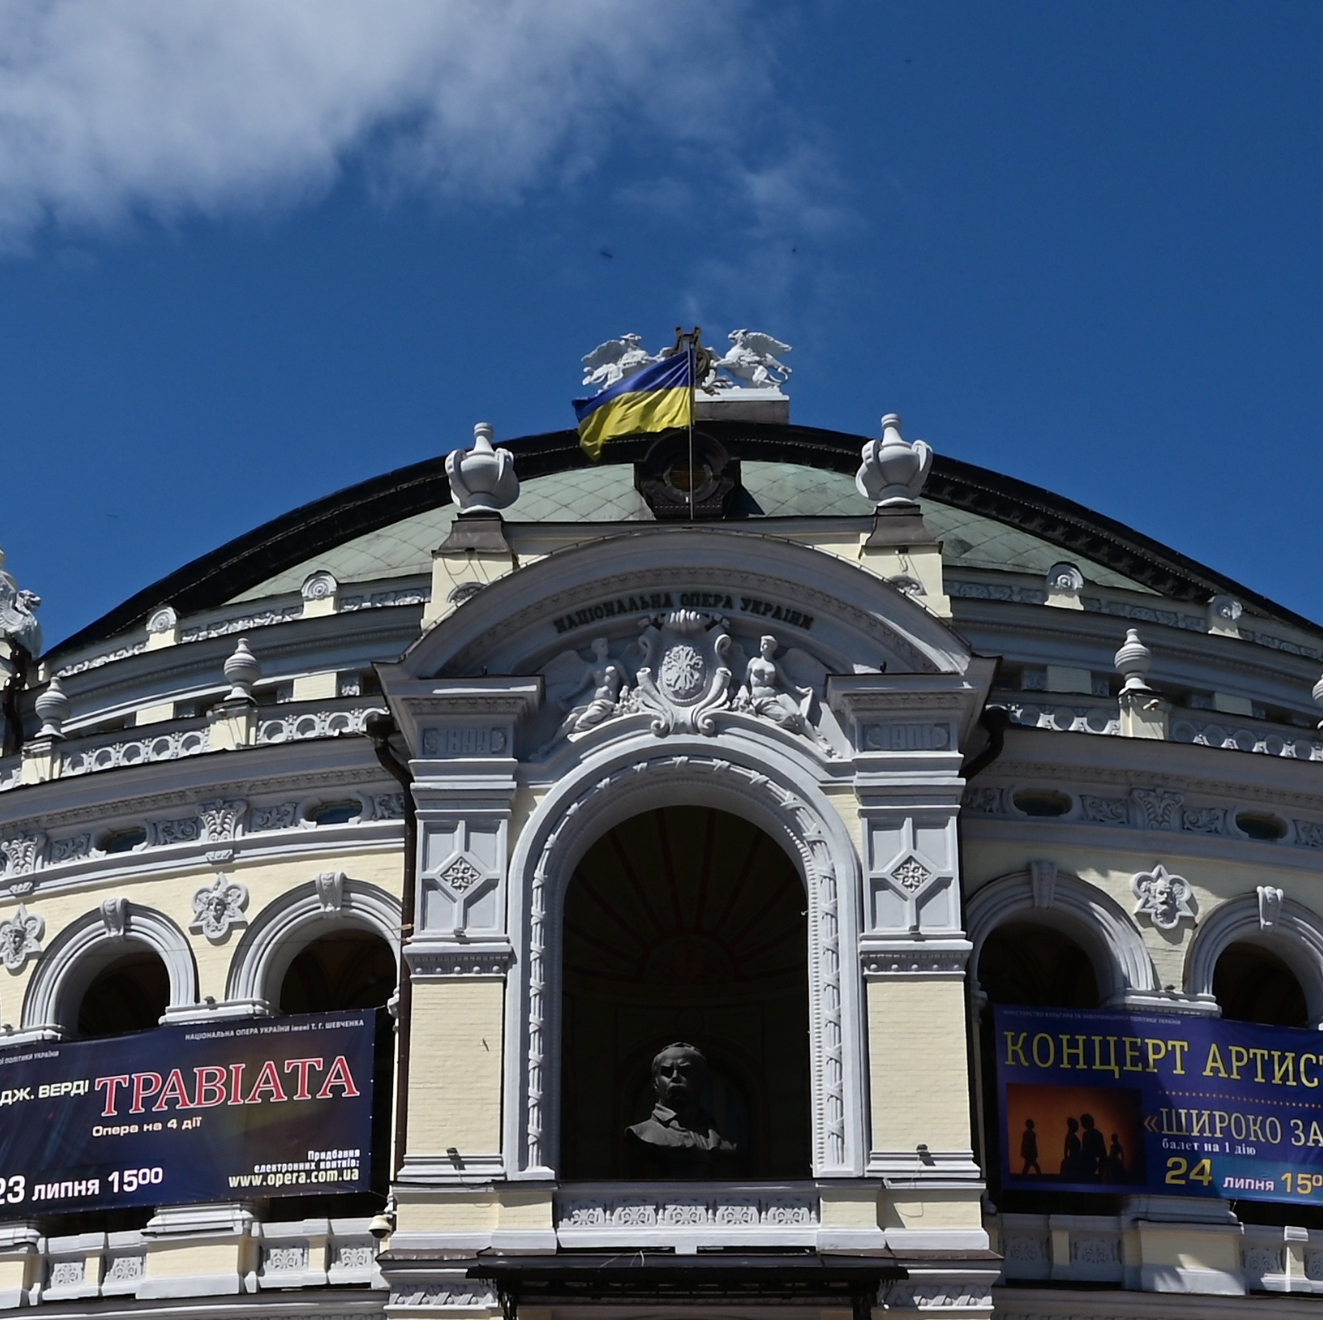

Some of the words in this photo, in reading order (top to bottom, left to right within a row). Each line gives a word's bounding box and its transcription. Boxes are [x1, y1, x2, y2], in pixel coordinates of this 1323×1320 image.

[554, 592, 674, 634] НАЦІОНАЛЬНА
[680, 592, 733, 609] ОПЕРА
[185, 1030, 234, 1041] НАЦІОНАЛЬНА
[236, 1027, 258, 1037] ОПЕРА
[260, 1024, 290, 1034] УКРАЇНИ
[325, 1019, 364, 1029] ШЕВЧЕНКА
[1003, 1031, 1188, 1079] КОНЦЕРТ
[0, 1090, 35, 1106] ДЖ.
[38, 1080, 89, 1100] ВЕРДІ
[95, 1055, 361, 1117] ТРАВІАТА
[92, 1124, 138, 1137] Опера
[143, 1121, 162, 1132] на
[167, 1118, 178, 1129] 4
[181, 1116, 202, 1130] дії
[1144, 1108, 1281, 1144] «ШИРОКО
[307, 1149, 360, 1161] Придбання
[1162, 1138, 1199, 1151] балет
[1204, 1143, 1220, 1153] на
[1225, 1142, 1230, 1153] 1
[1234, 1143, 1256, 1156] дію
[228, 1168, 359, 1188] www.opera.com.ua
[254, 1161, 316, 1174] електронних
[1165, 1156, 1212, 1186] 24
[1223, 1177, 1275, 1191] липня
[32, 1179, 100, 1201] липня
[108, 1167, 163, 1193] 1500
